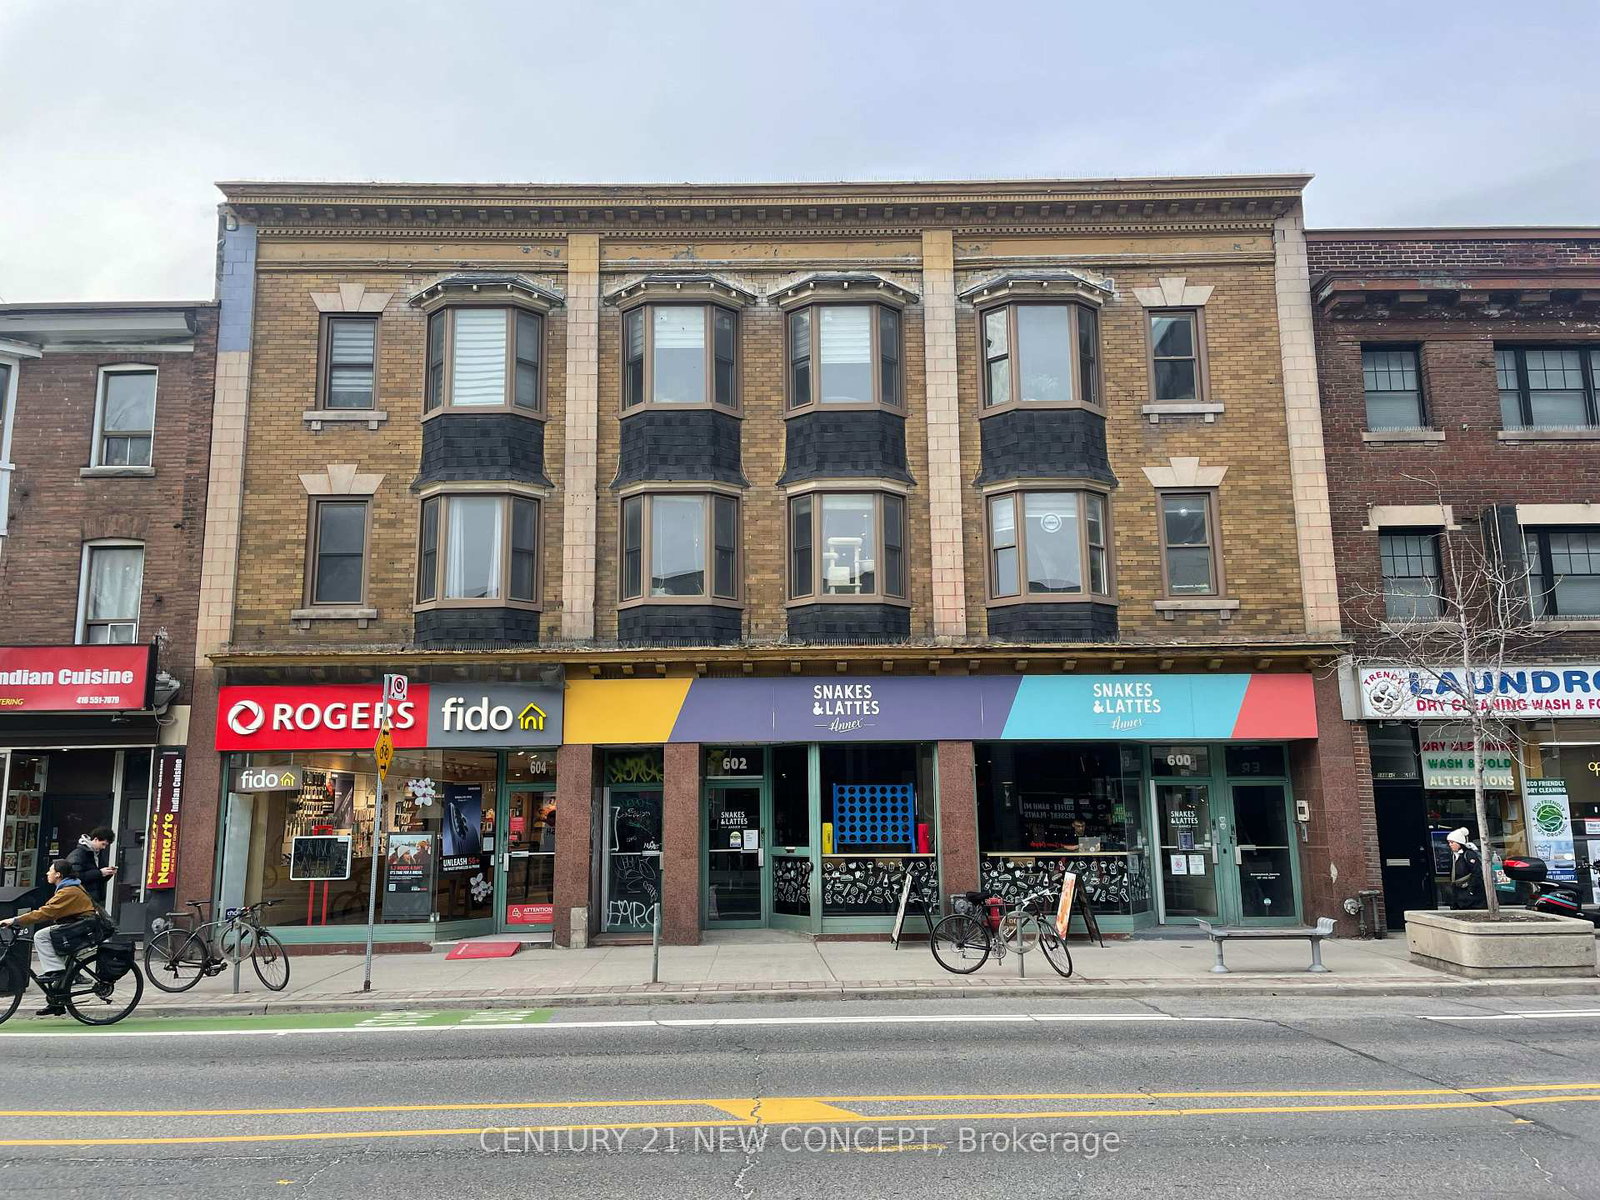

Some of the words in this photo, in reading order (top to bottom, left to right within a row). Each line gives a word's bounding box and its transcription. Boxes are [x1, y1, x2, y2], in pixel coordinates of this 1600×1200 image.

[58, 669, 133, 685] Cuisine
[1363, 671, 1405, 687] TRENDY
[1409, 671, 1600, 695] LAUNDR
[813, 684, 873, 699] SNAKES
[1093, 683, 1153, 698] SNAKES
[812, 700, 880, 715] &LATTES
[1093, 699, 1161, 714] &LATTES
[1416, 699, 1446, 711] DRY
[1531, 699, 1571, 710] WASH
[1575, 699, 1585, 710] &
[272, 701, 415, 731] ROGERS
[441, 696, 514, 732] fido
[828, 717, 865, 733] Annex
[1111, 715, 1145, 732] Annex
[1422, 741, 1446, 752] DRY
[1451, 740, 1512, 752] CLENING
[530, 760, 547, 775] 604
[722, 756, 748, 770] 602
[1167, 754, 1191, 766] 600
[1428, 758, 1463, 769] WASH
[1468, 758, 1475, 769] &
[1482, 758, 1512, 769] OLD
[172, 758, 183, 787] Cuisine
[240, 769, 279, 789] fido
[1429, 775, 1515, 786] ALTERAIONS
[171, 787, 180, 813] Indian
[720, 811, 746, 819] SNAKES
[1170, 810, 1196, 818] SNAKES
[157, 813, 174, 885] Namaste
[442, 857, 468, 867] UNLEASH
